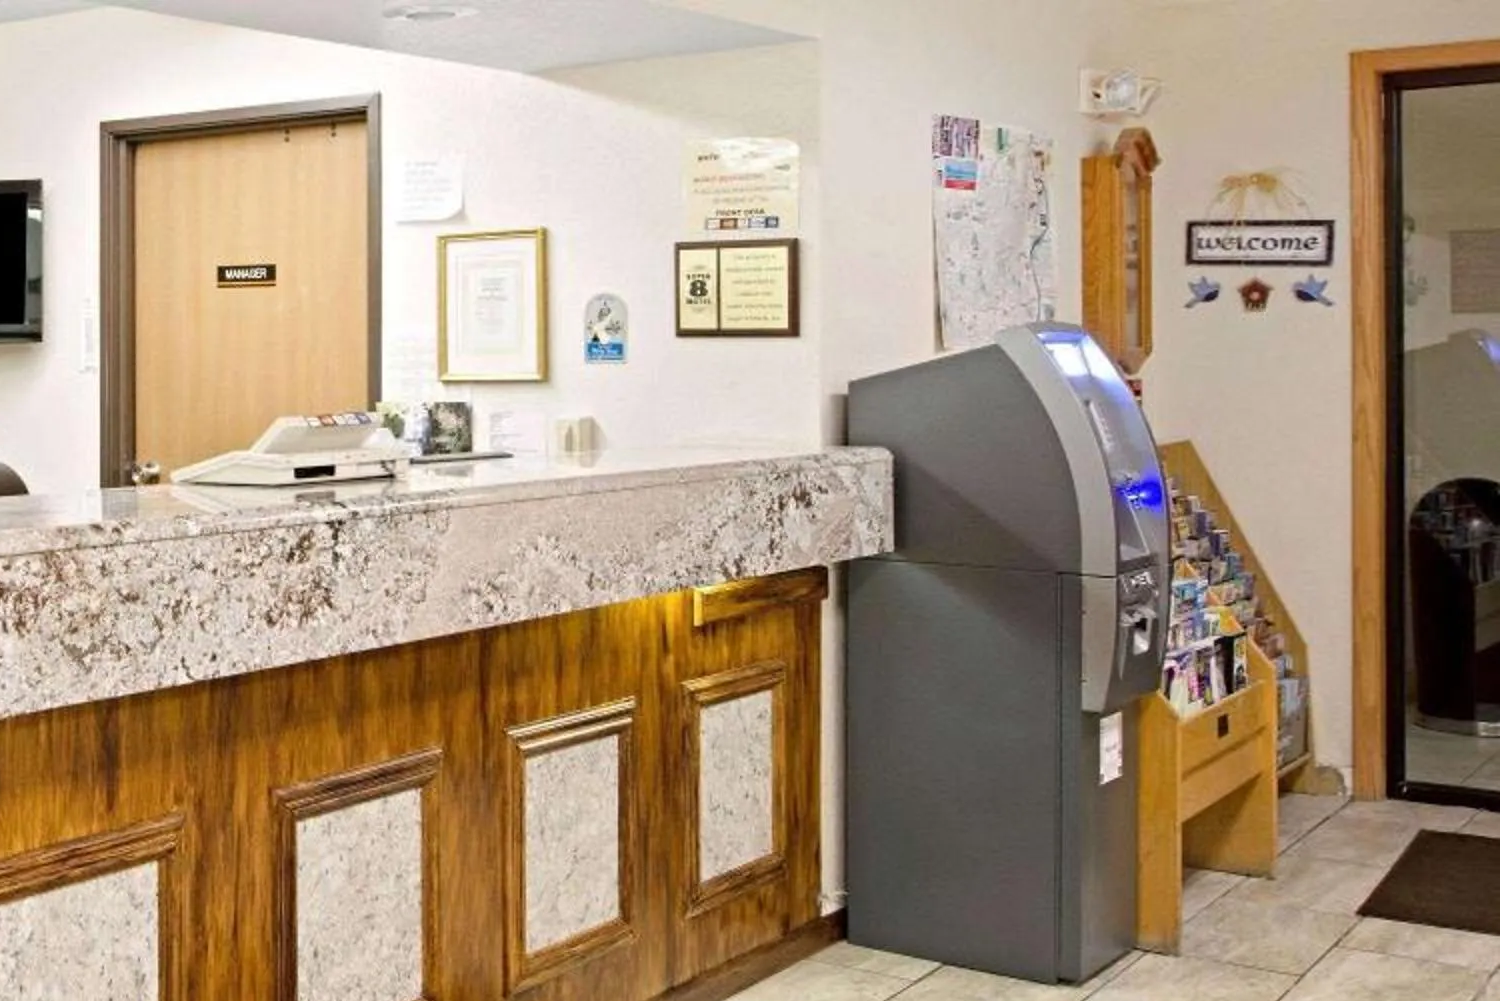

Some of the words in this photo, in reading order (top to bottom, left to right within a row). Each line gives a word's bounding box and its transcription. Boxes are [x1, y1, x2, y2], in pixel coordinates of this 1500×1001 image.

[1196, 236, 1320, 251] welcome
[225, 267, 268, 280] MANAGER
[689, 279, 709, 297] 8
